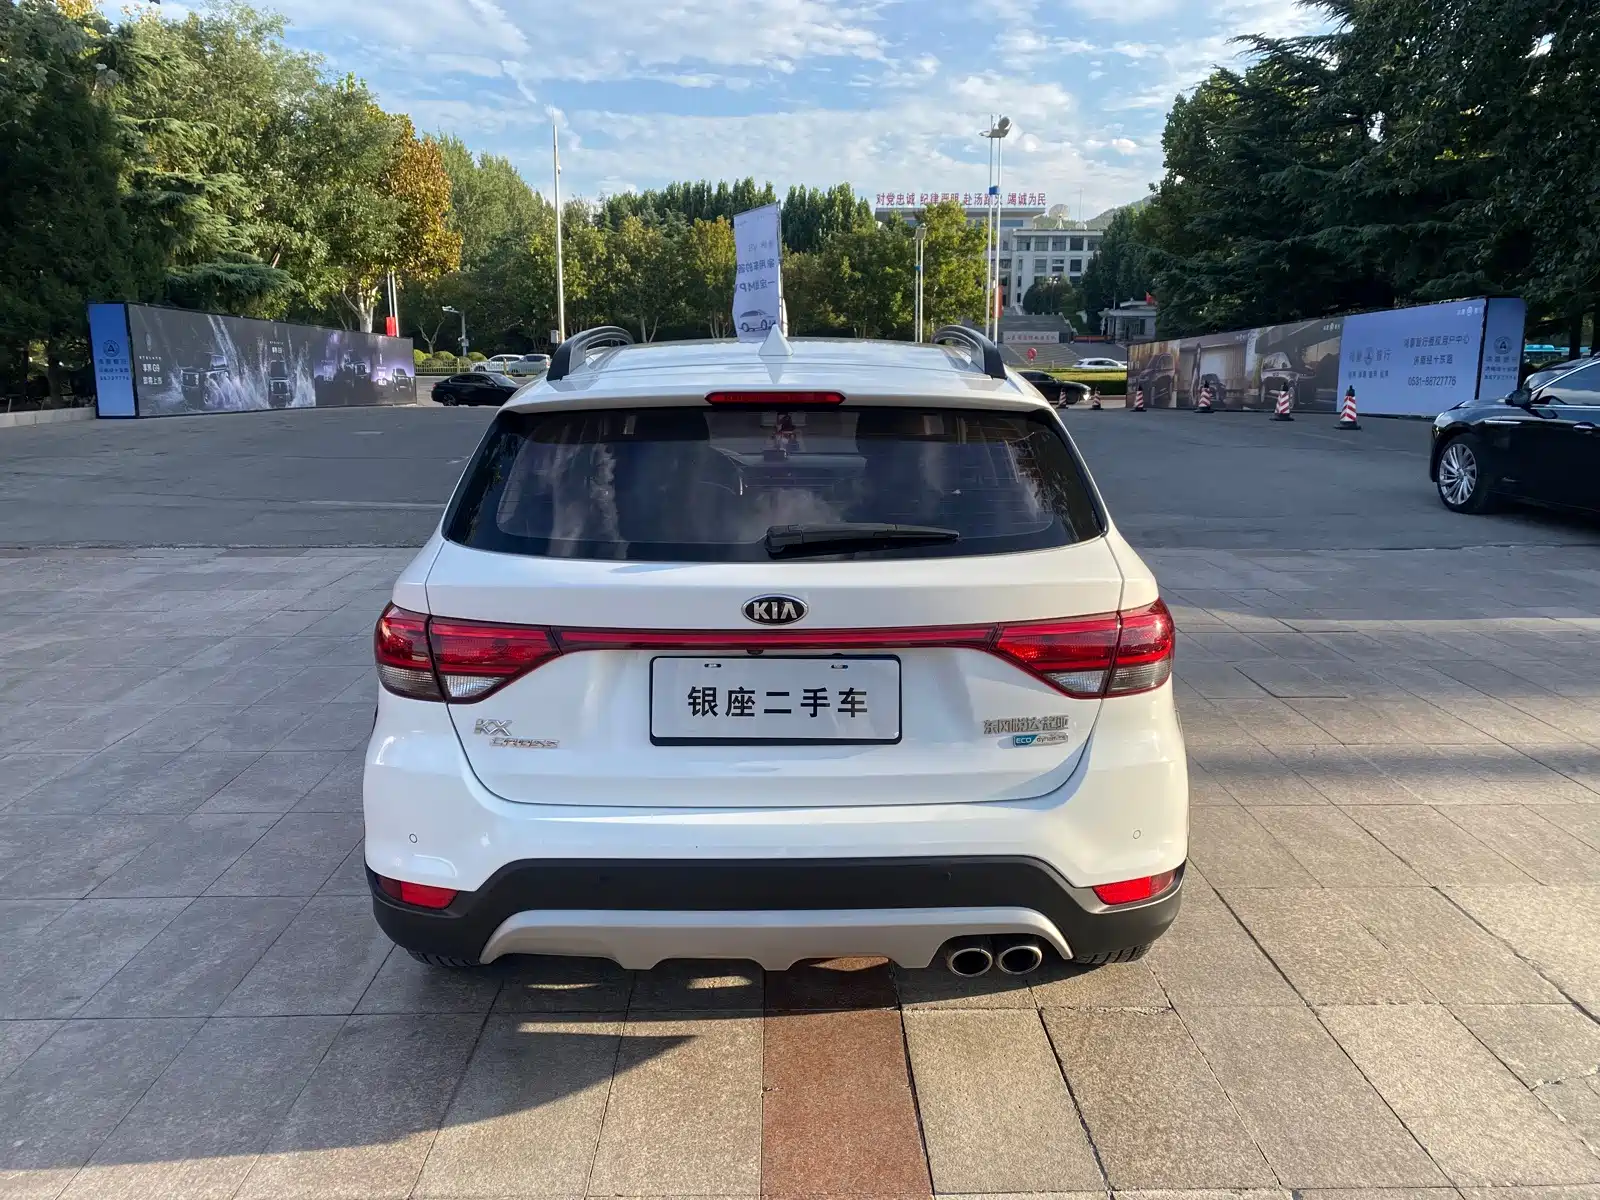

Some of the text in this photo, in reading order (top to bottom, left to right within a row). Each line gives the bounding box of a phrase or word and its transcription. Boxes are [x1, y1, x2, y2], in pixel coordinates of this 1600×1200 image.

[876, 193, 915, 206] 对党忠诚
[1007, 193, 1046, 206] 竭诚为民
[753, 601, 798, 620] KIA
[687, 686, 867, 718] 银座二手车
[474, 718, 512, 736] KX
